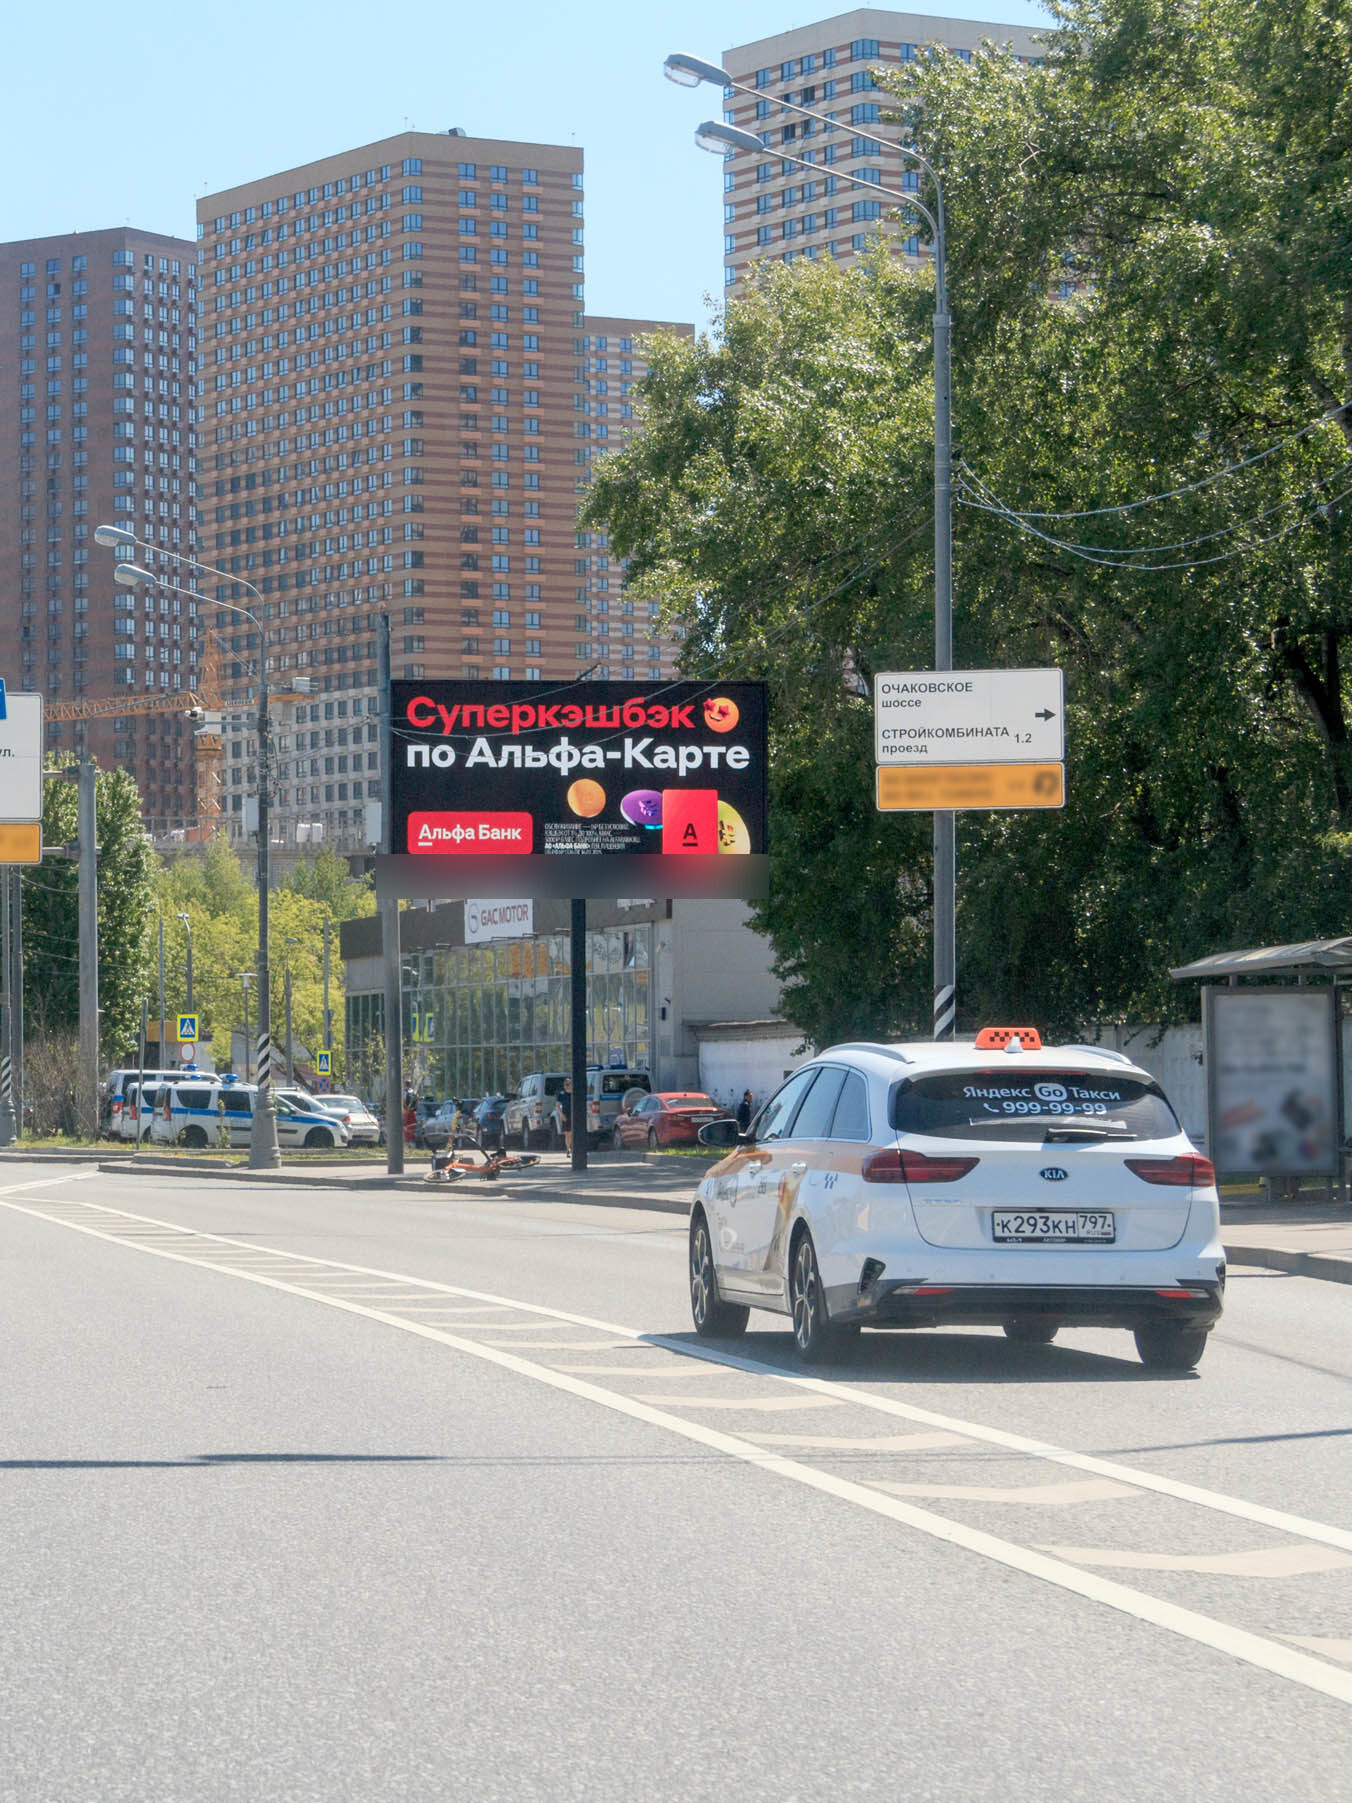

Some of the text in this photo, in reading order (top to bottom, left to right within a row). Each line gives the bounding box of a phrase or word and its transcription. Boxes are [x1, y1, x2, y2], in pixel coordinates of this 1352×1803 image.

[881, 682, 974, 695] ОЧАКОВСКОЕ
[881, 699, 922, 708] шоссе
[406, 696, 696, 736] Суперкэшбэк
[881, 726, 1033, 744] СТРОЙКОМБИНАТА 1.2
[407, 736, 750, 777] по Альфа-Карте
[882, 745, 928, 755] проезд
[418, 822, 522, 844] Альфа Банк
[480, 904, 529, 926] GAC MOTOR
[963, 1086, 1121, 1100] Яндекс Go Такси
[1002, 1101, 1107, 1115] 999-99-99
[1044, 1169, 1065, 1179] KIA
[1001, 1215, 1108, 1234] К293КН 797
